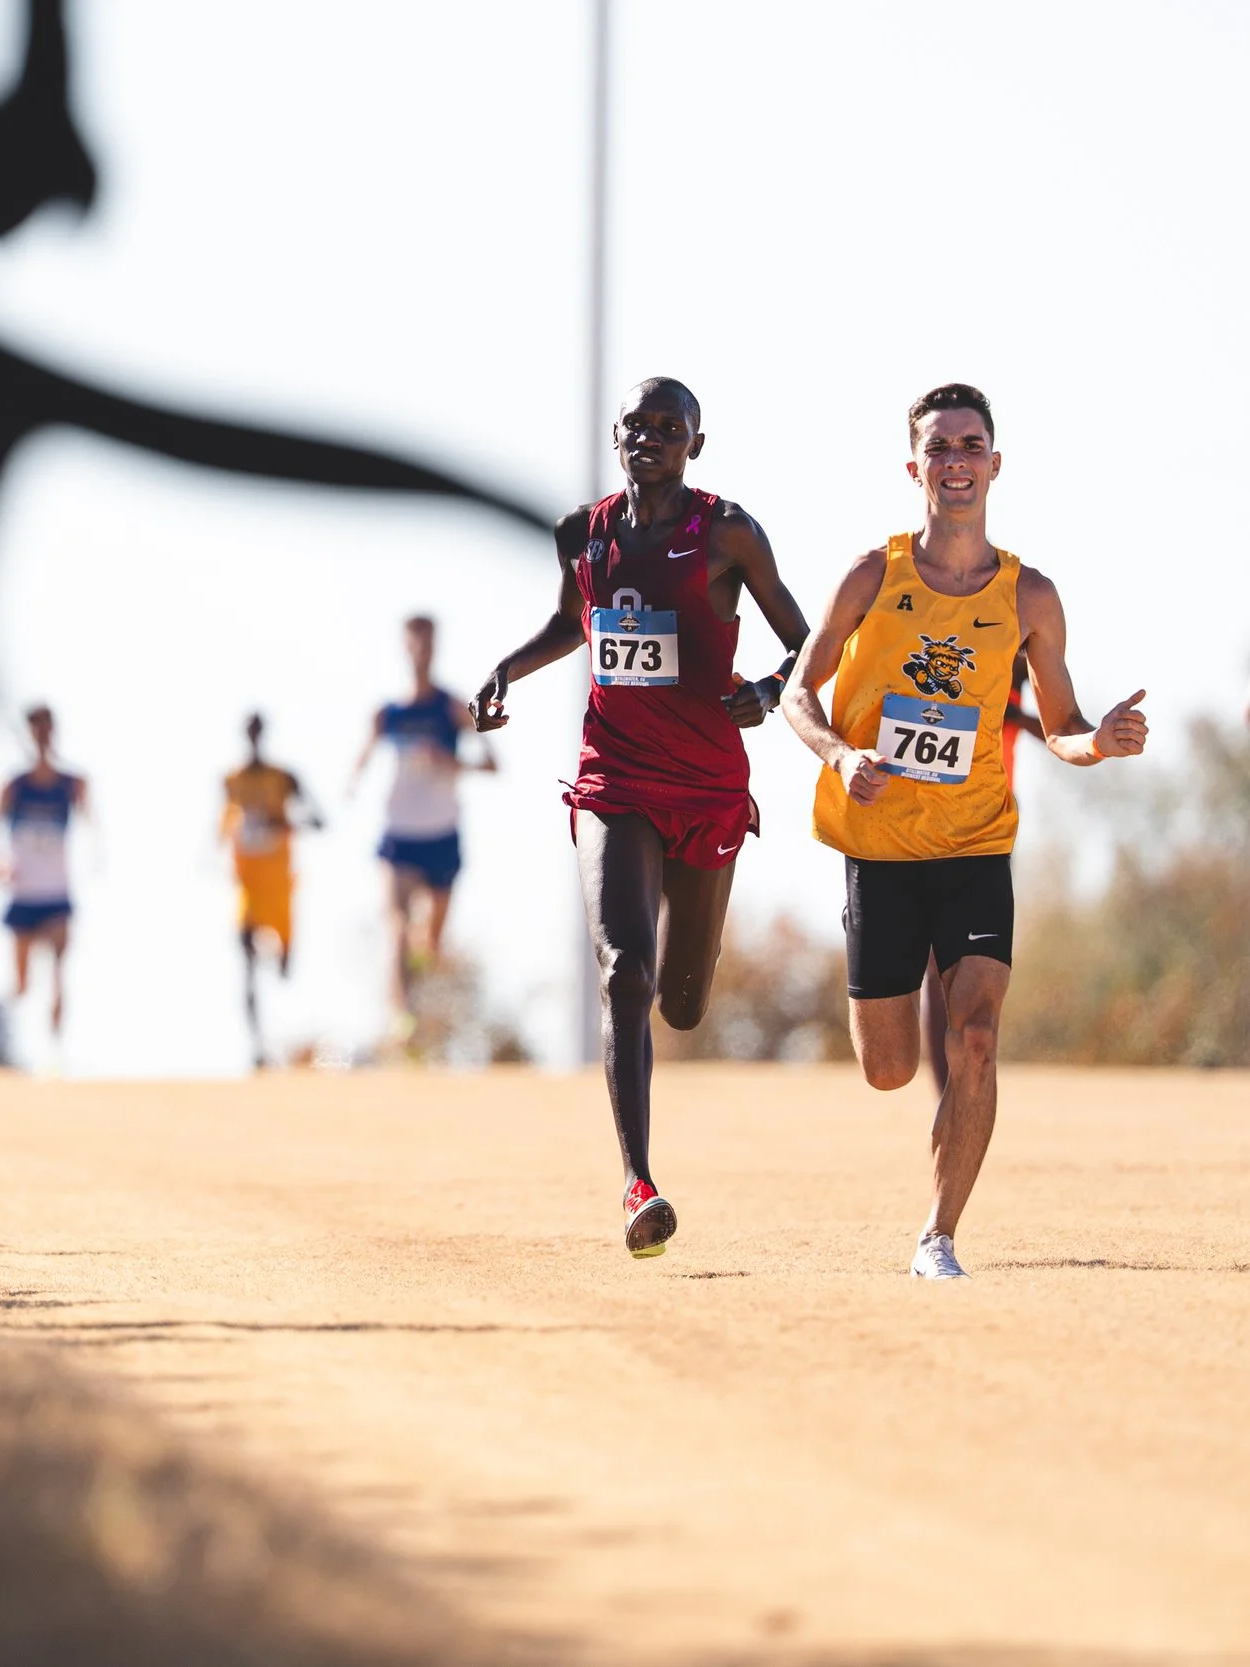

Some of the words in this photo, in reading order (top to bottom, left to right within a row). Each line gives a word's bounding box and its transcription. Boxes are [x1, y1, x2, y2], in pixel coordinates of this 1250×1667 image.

[586, 540, 603, 560] SEC
[896, 594, 913, 611] A
[599, 638, 662, 671] 673
[893, 726, 960, 768] 764
